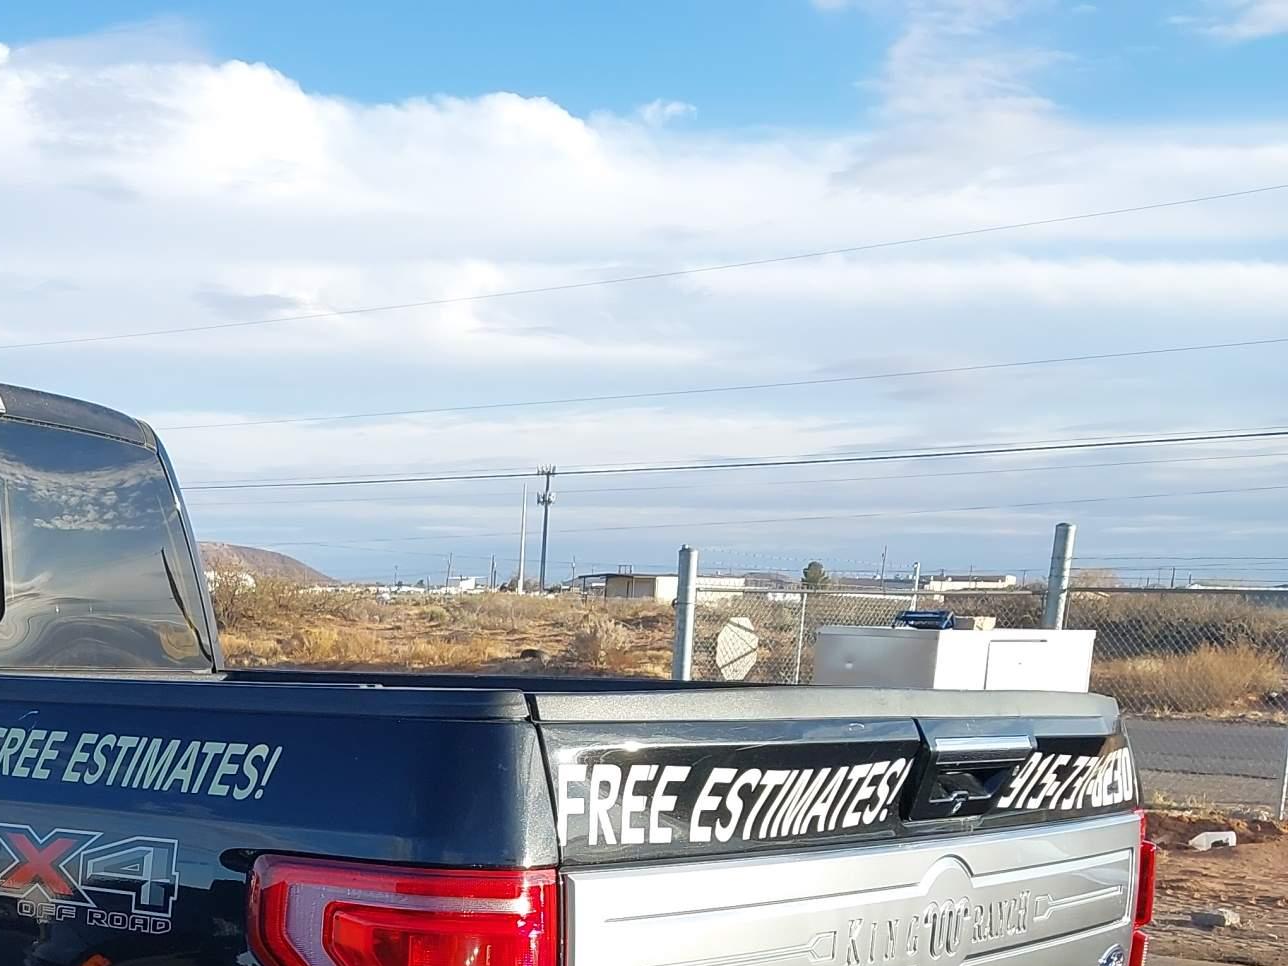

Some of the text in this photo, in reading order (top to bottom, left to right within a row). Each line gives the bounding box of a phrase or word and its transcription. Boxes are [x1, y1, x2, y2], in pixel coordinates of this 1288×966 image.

[62, 733, 282, 800] ESTIMATES!
[558, 757, 914, 846] FREE ESTIMATES!
[17, 901, 172, 934] OFF ROAD
[845, 890, 1031, 966] KING RANCH
